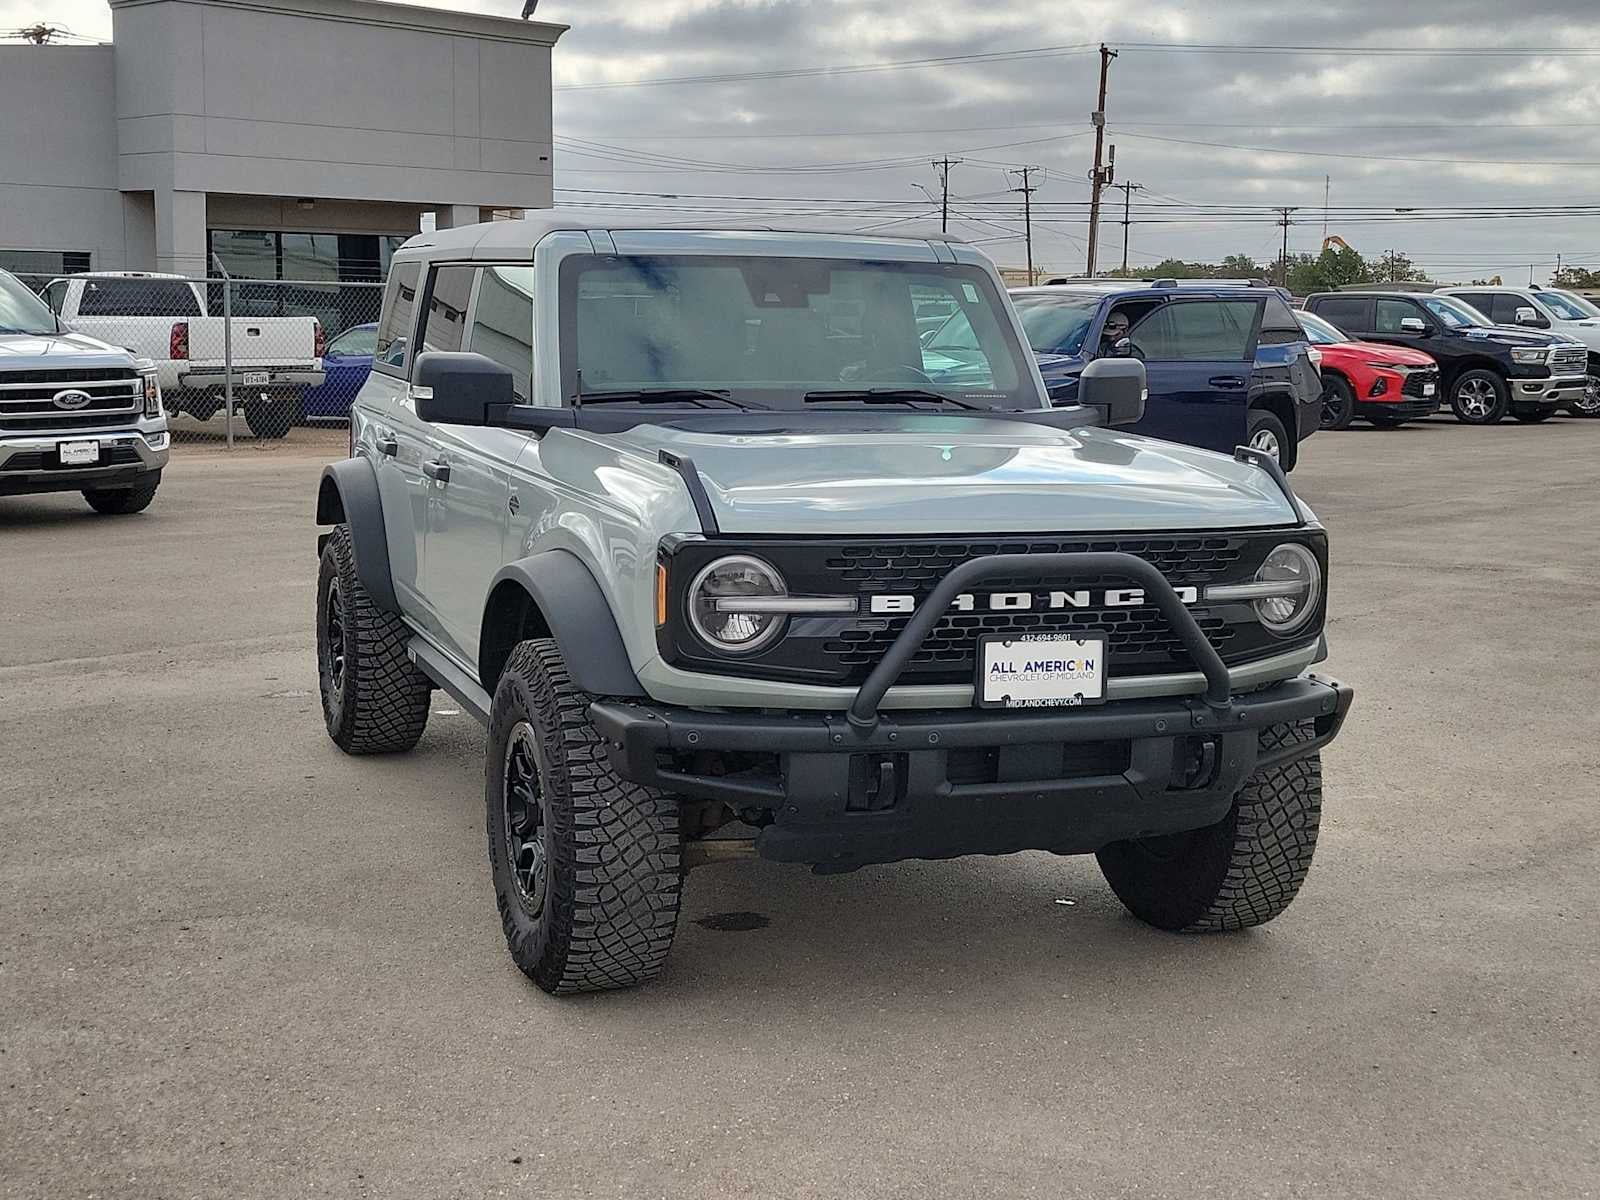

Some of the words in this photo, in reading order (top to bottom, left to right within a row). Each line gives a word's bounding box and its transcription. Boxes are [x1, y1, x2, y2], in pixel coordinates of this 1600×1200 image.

[1020, 633, 1071, 641] 432-694-9601
[990, 662, 1017, 674] ALL
[1023, 659, 1094, 673] AMERICN
[990, 673, 1041, 682] CHEVROLET
[1042, 672, 1055, 681] OF
[1056, 671, 1095, 680] MIDLAND
[1005, 698, 1082, 708] MIDLANDCHEVY.COM
